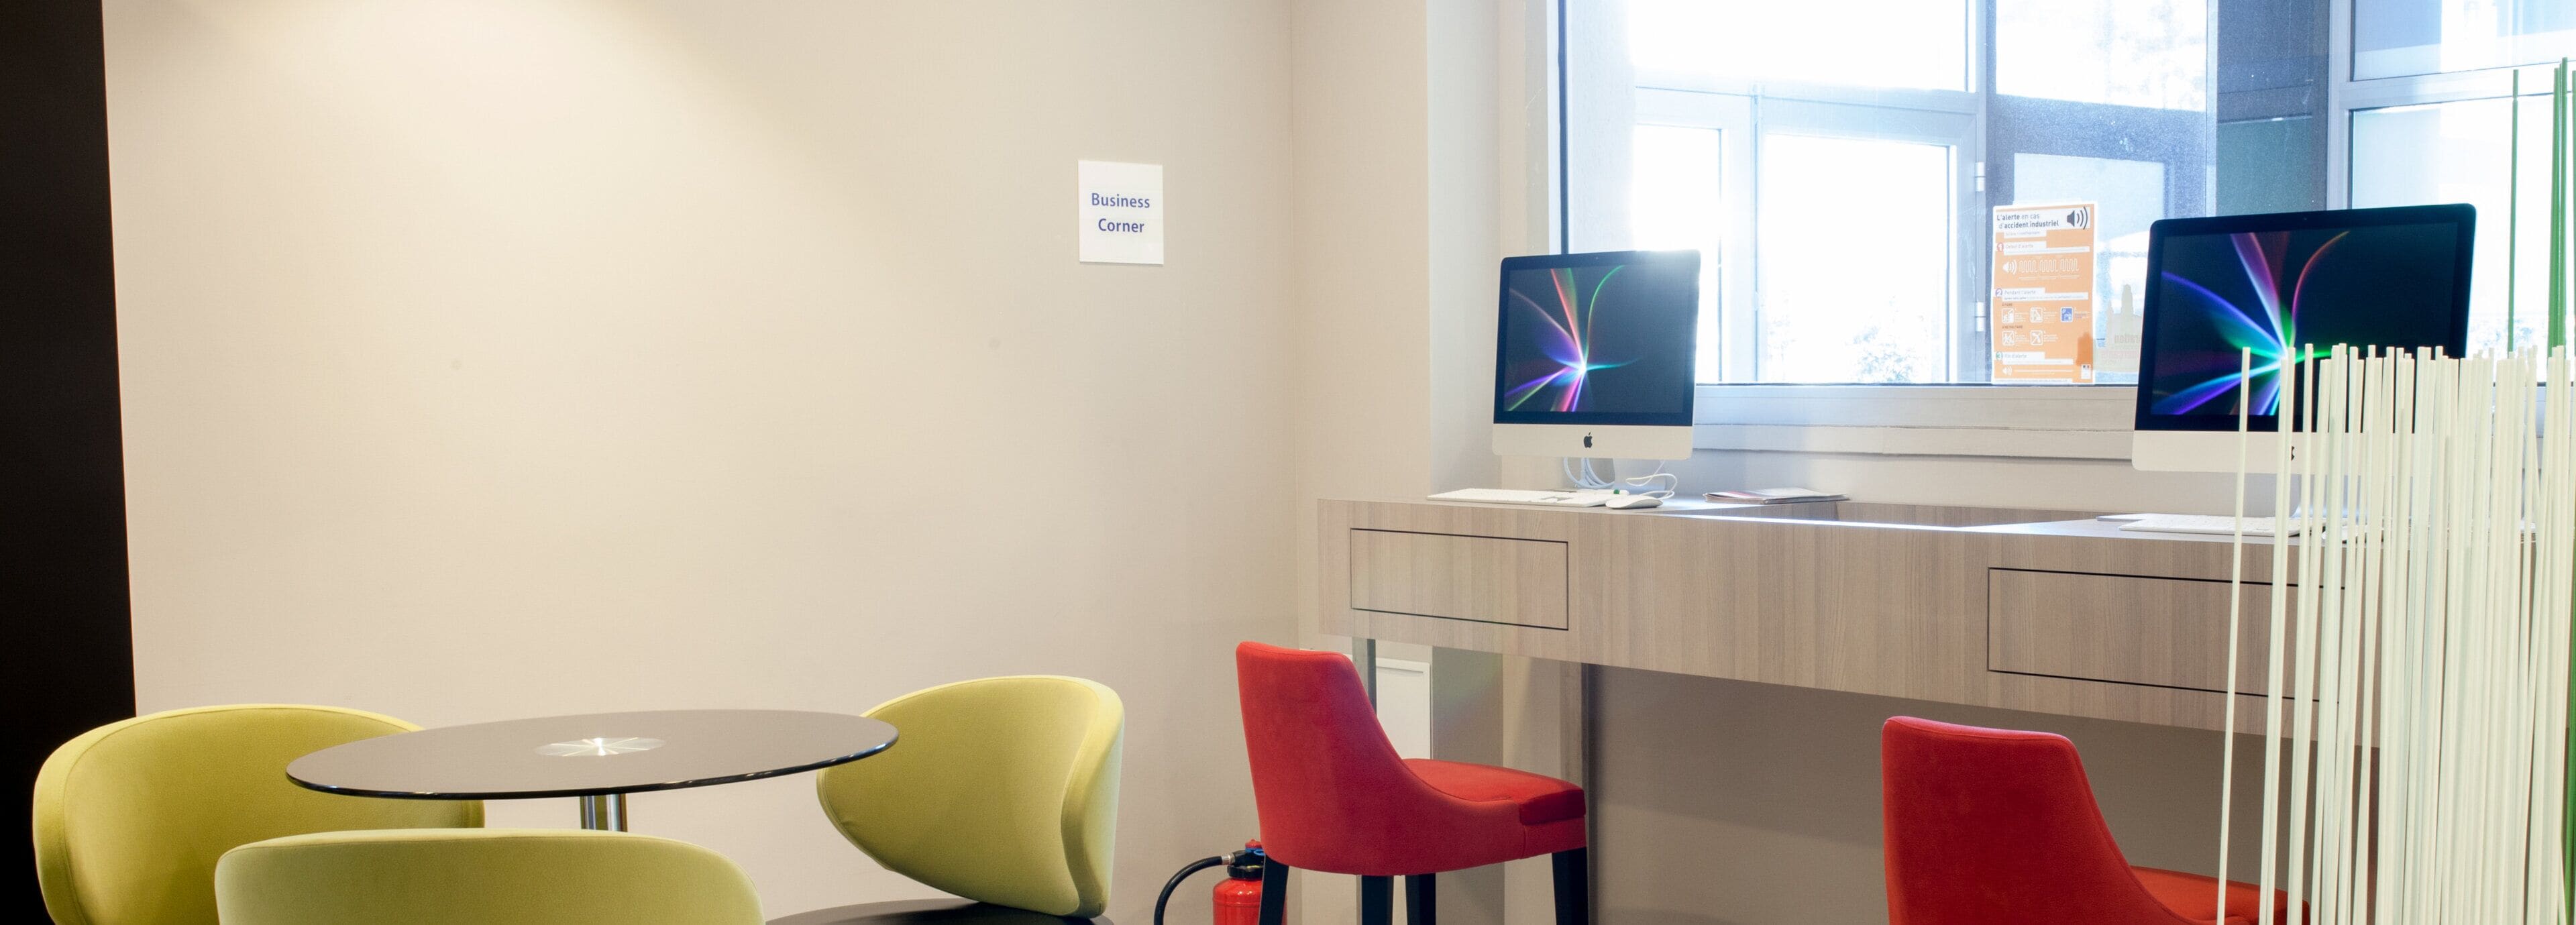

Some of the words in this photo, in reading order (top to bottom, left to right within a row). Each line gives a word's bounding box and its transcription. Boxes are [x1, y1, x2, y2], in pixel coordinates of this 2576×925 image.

[1091, 193, 1150, 209] Business
[1098, 218, 1144, 233] Corner
[2029, 219, 2059, 227] industriel
